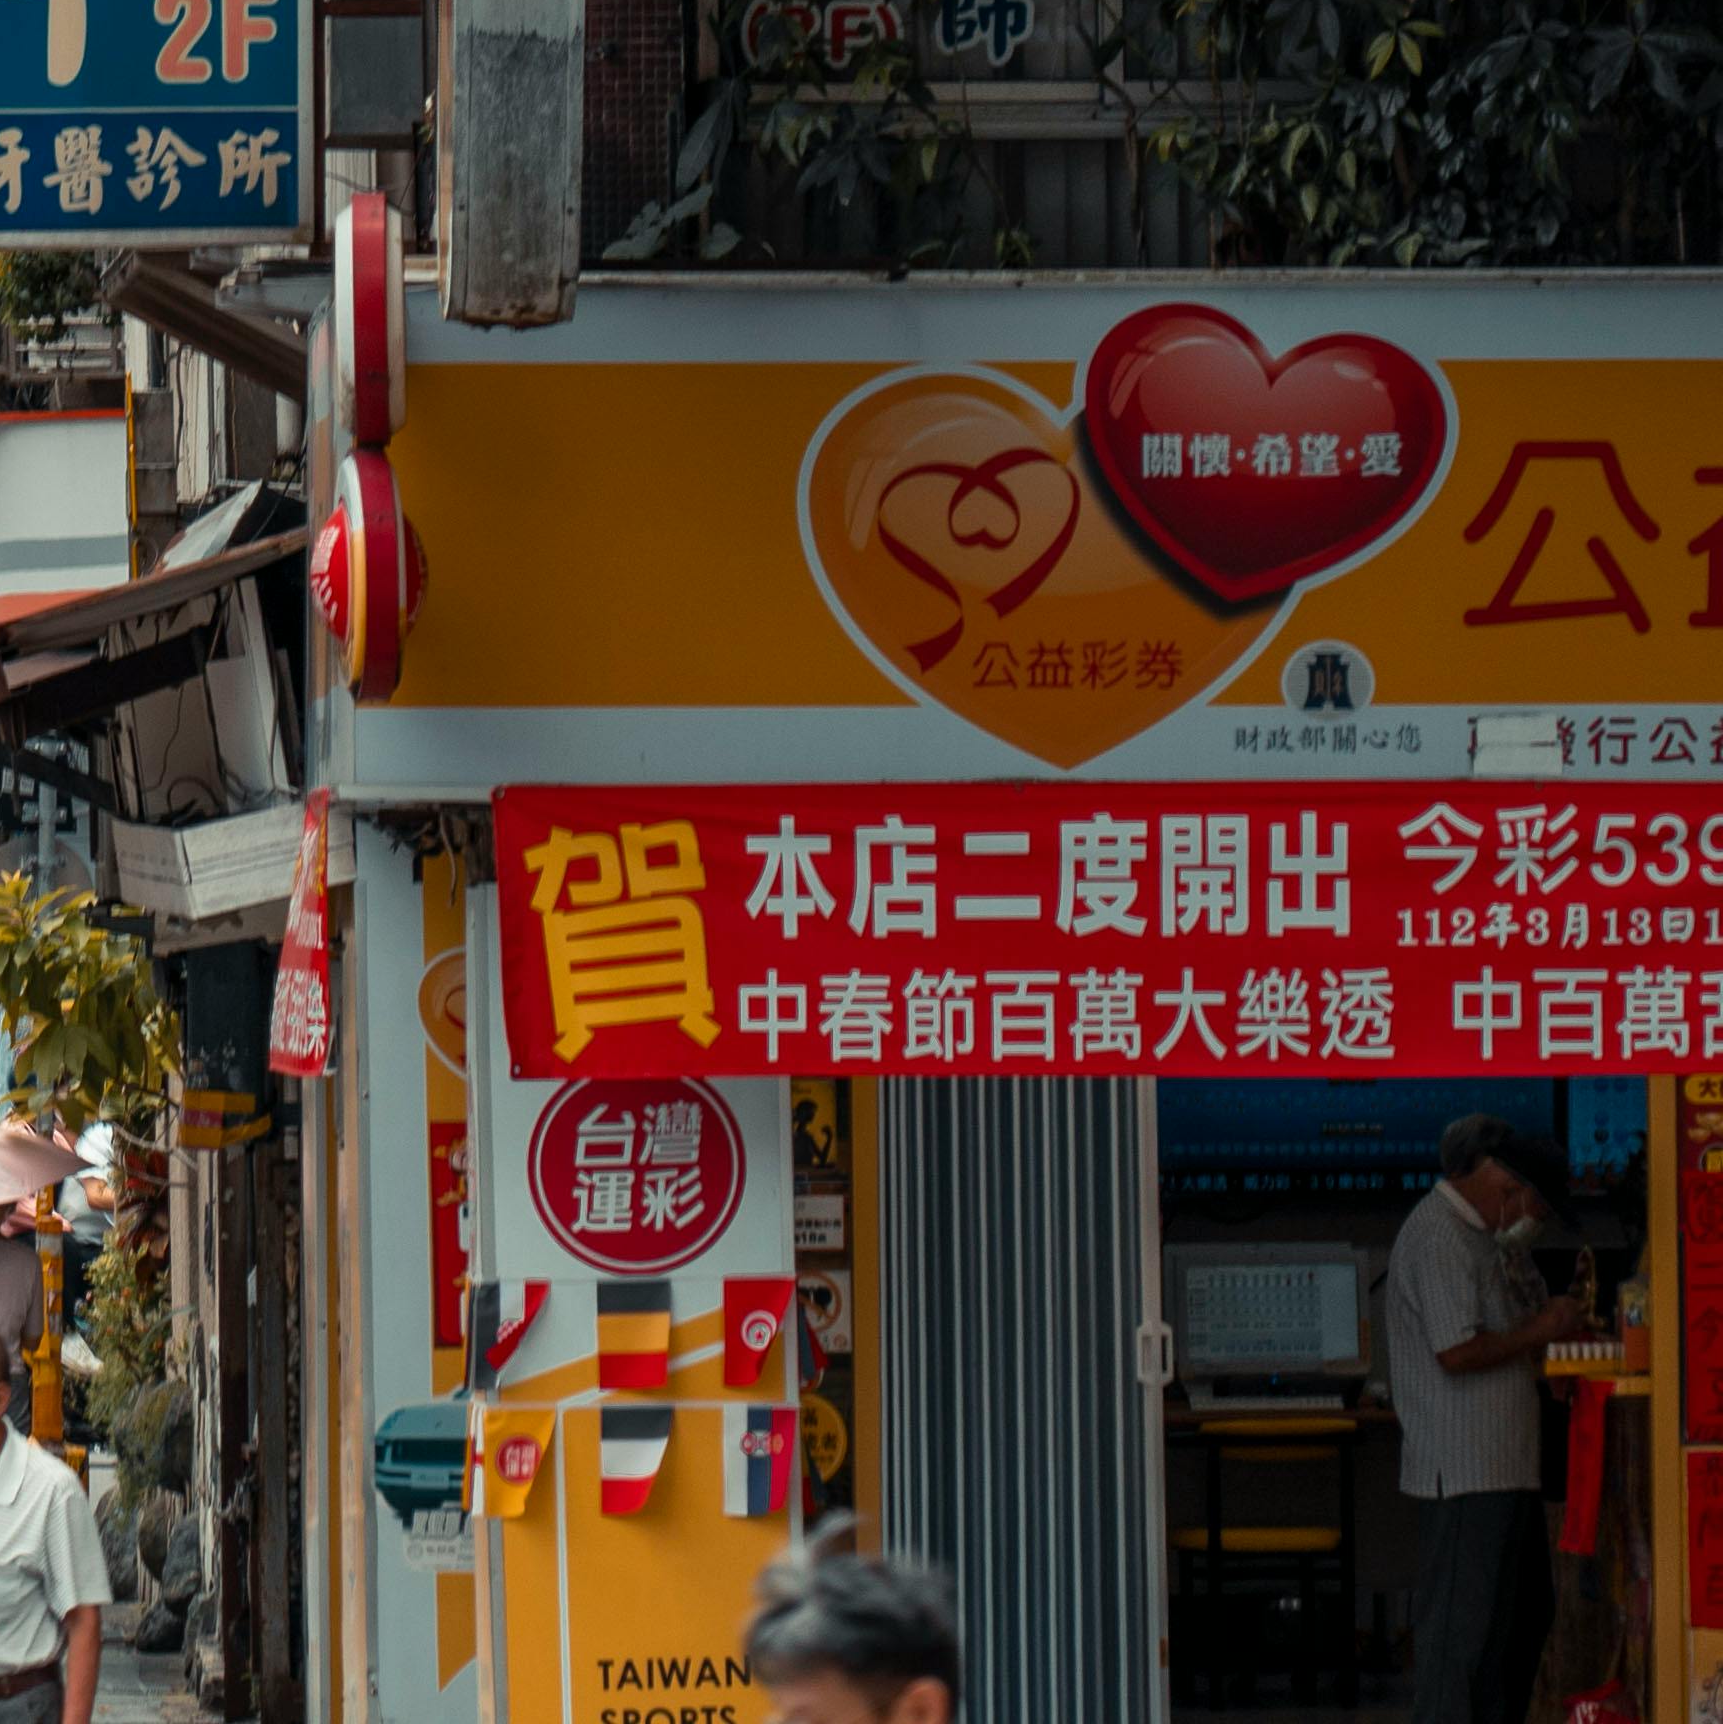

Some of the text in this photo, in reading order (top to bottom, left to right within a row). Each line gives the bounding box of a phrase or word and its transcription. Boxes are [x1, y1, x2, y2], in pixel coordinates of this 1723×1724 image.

[1462, 440, 1723, 635] 公
[971, 639, 1185, 693] 公益彩券
[744, 810, 1352, 940] 本店二度開出
[524, 819, 723, 1064] 賀
[738, 966, 1396, 1063] 中春節百萬大樂透
[574, 1099, 704, 1169] 台灣
[570, 1166, 706, 1235] 運彩
[596, 1655, 753, 1691] TAIWAN
